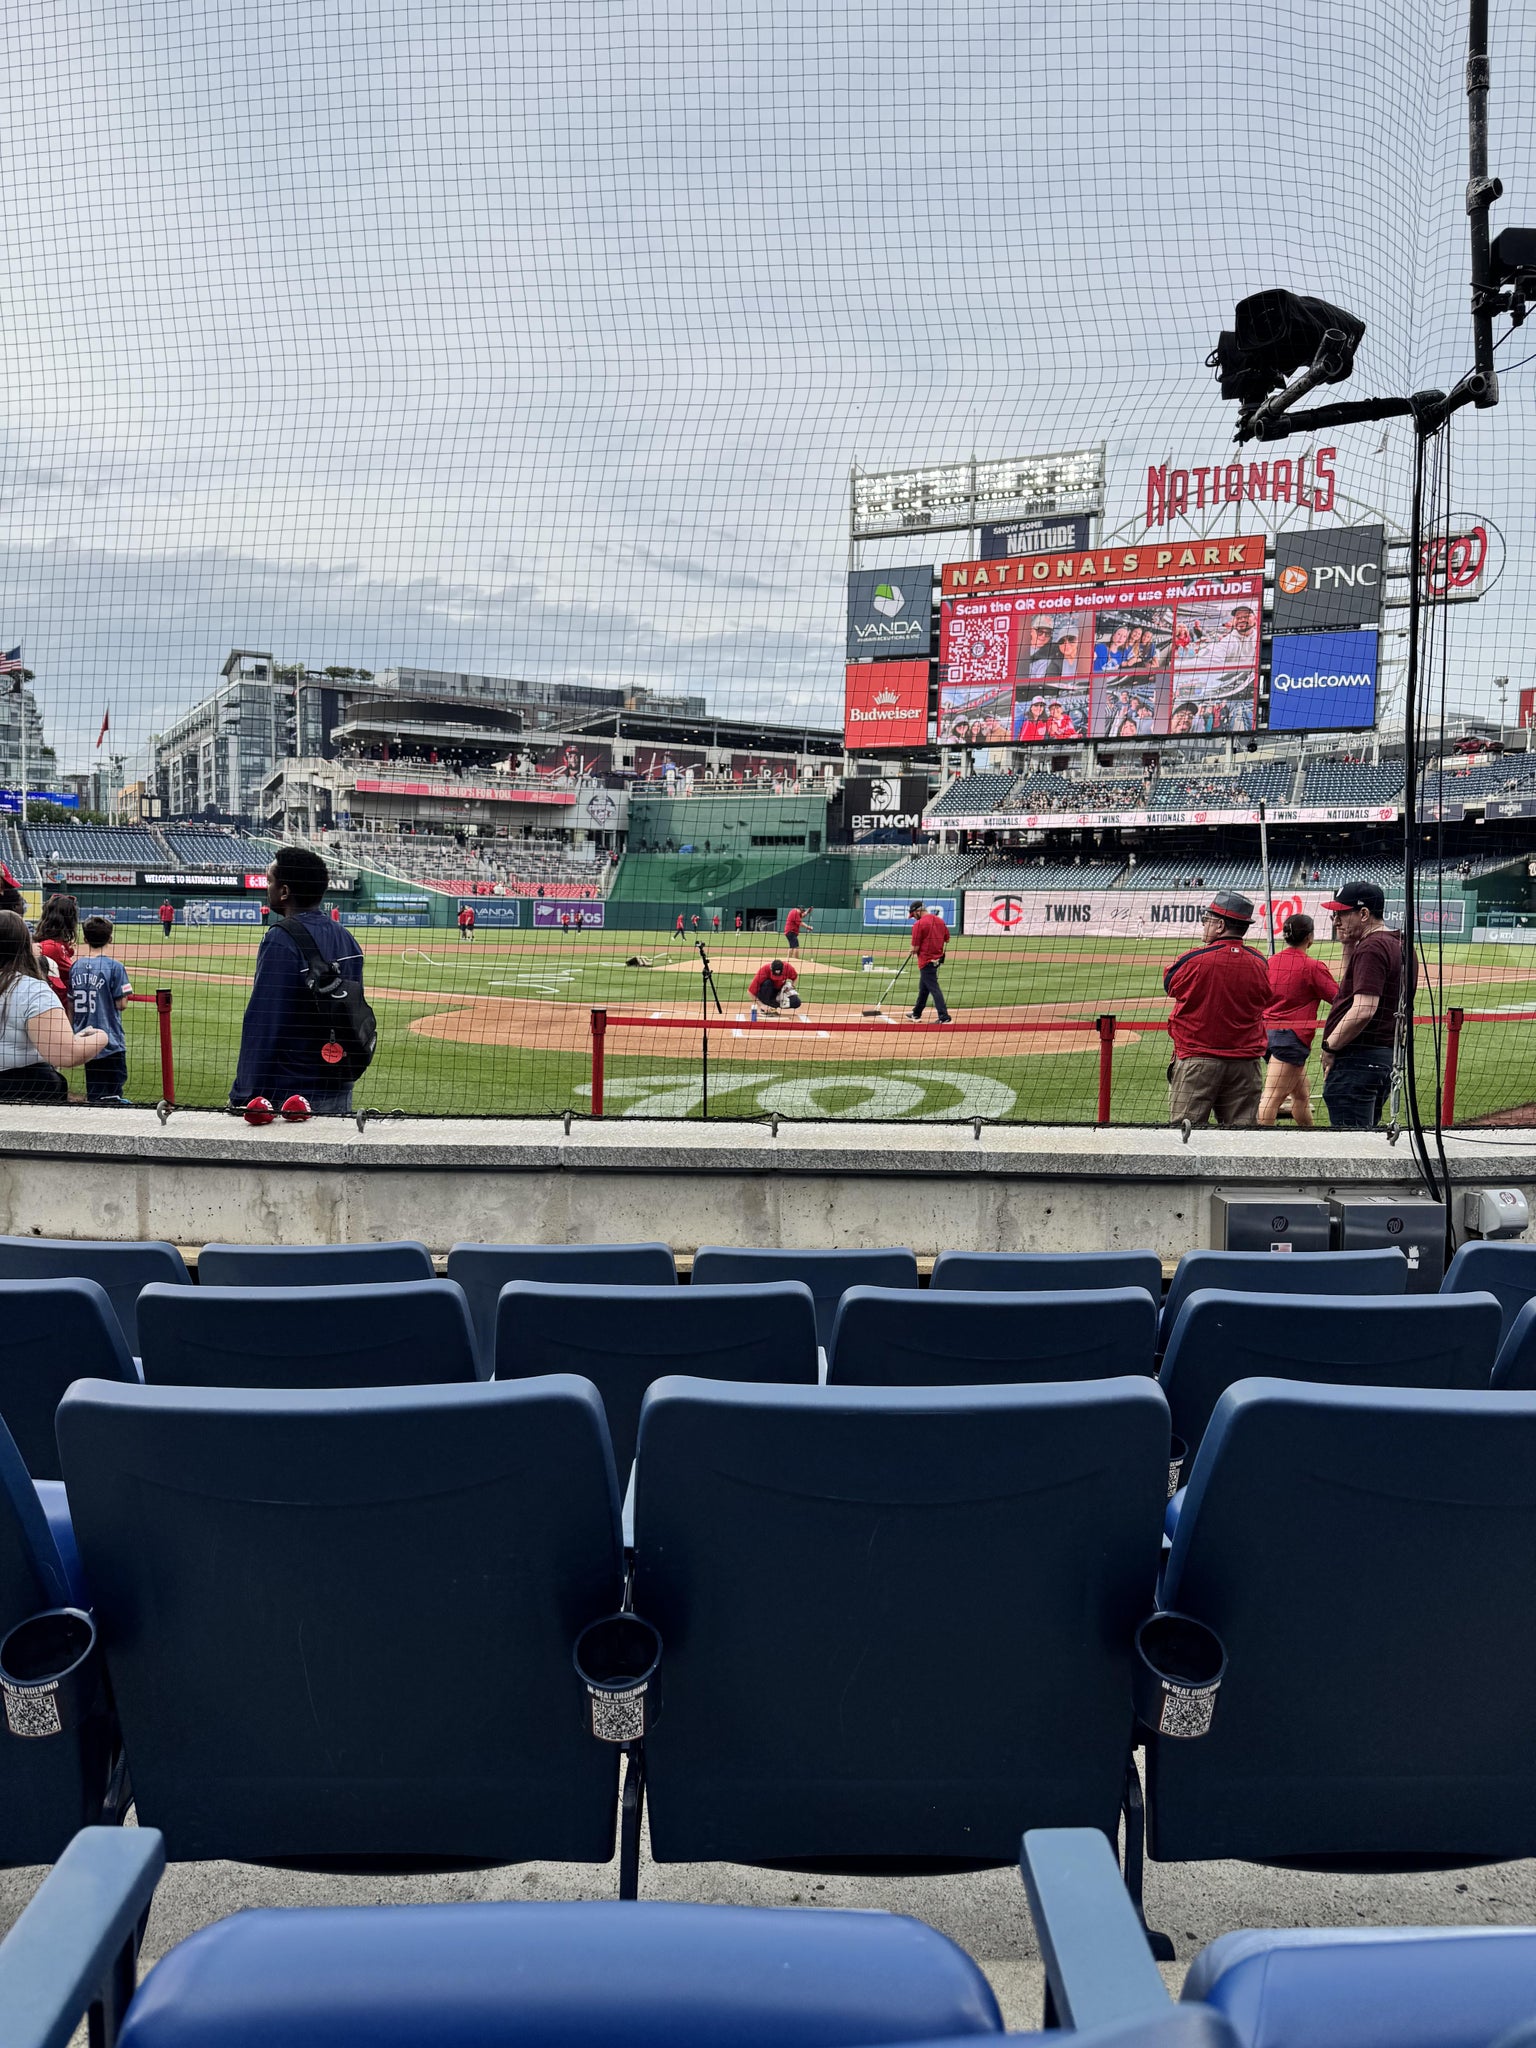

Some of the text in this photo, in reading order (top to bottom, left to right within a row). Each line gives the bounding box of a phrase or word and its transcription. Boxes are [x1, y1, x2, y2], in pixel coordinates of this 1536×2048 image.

[1146, 447, 1336, 528] NATIONALS
[993, 520, 1043, 535] SHOW SOME
[1007, 524, 1076, 554] NATITUDE
[952, 544, 1246, 587] NATIONALS PARK
[1312, 563, 1378, 590] PNC
[955, 581, 1253, 616] Scan the QR code below or use #NATITUDE
[854, 620, 924, 638] VANDA
[1274, 672, 1372, 692] Qualcomm
[850, 706, 922, 722] Budweiser
[428, 784, 511, 800] THIS BUD'S FOR YOU
[851, 814, 919, 829] BETMGM
[939, 817, 960, 828] TWINS
[983, 816, 1019, 827] NATIONALS
[1097, 814, 1121, 824] TWINS
[1146, 812, 1186, 823] NATIONALS
[1273, 810, 1298, 821] TWINS
[1326, 808, 1370, 819] NATIONALS
[66, 872, 134, 883] Harris Teeter
[144, 874, 238, 886] WELCOME TO NATIONALS PARK
[211, 905, 257, 920] Terra
[475, 908, 515, 917] VANDA
[873, 905, 944, 921] GEIO
[1045, 904, 1091, 923] TWINS
[72, 972, 106, 990] AUTHOR
[74, 990, 97, 1014] 26
[586, 1681, 649, 1700] IN-SEAT ORDERING
[1161, 1679, 1191, 1696] IN-SEAT
